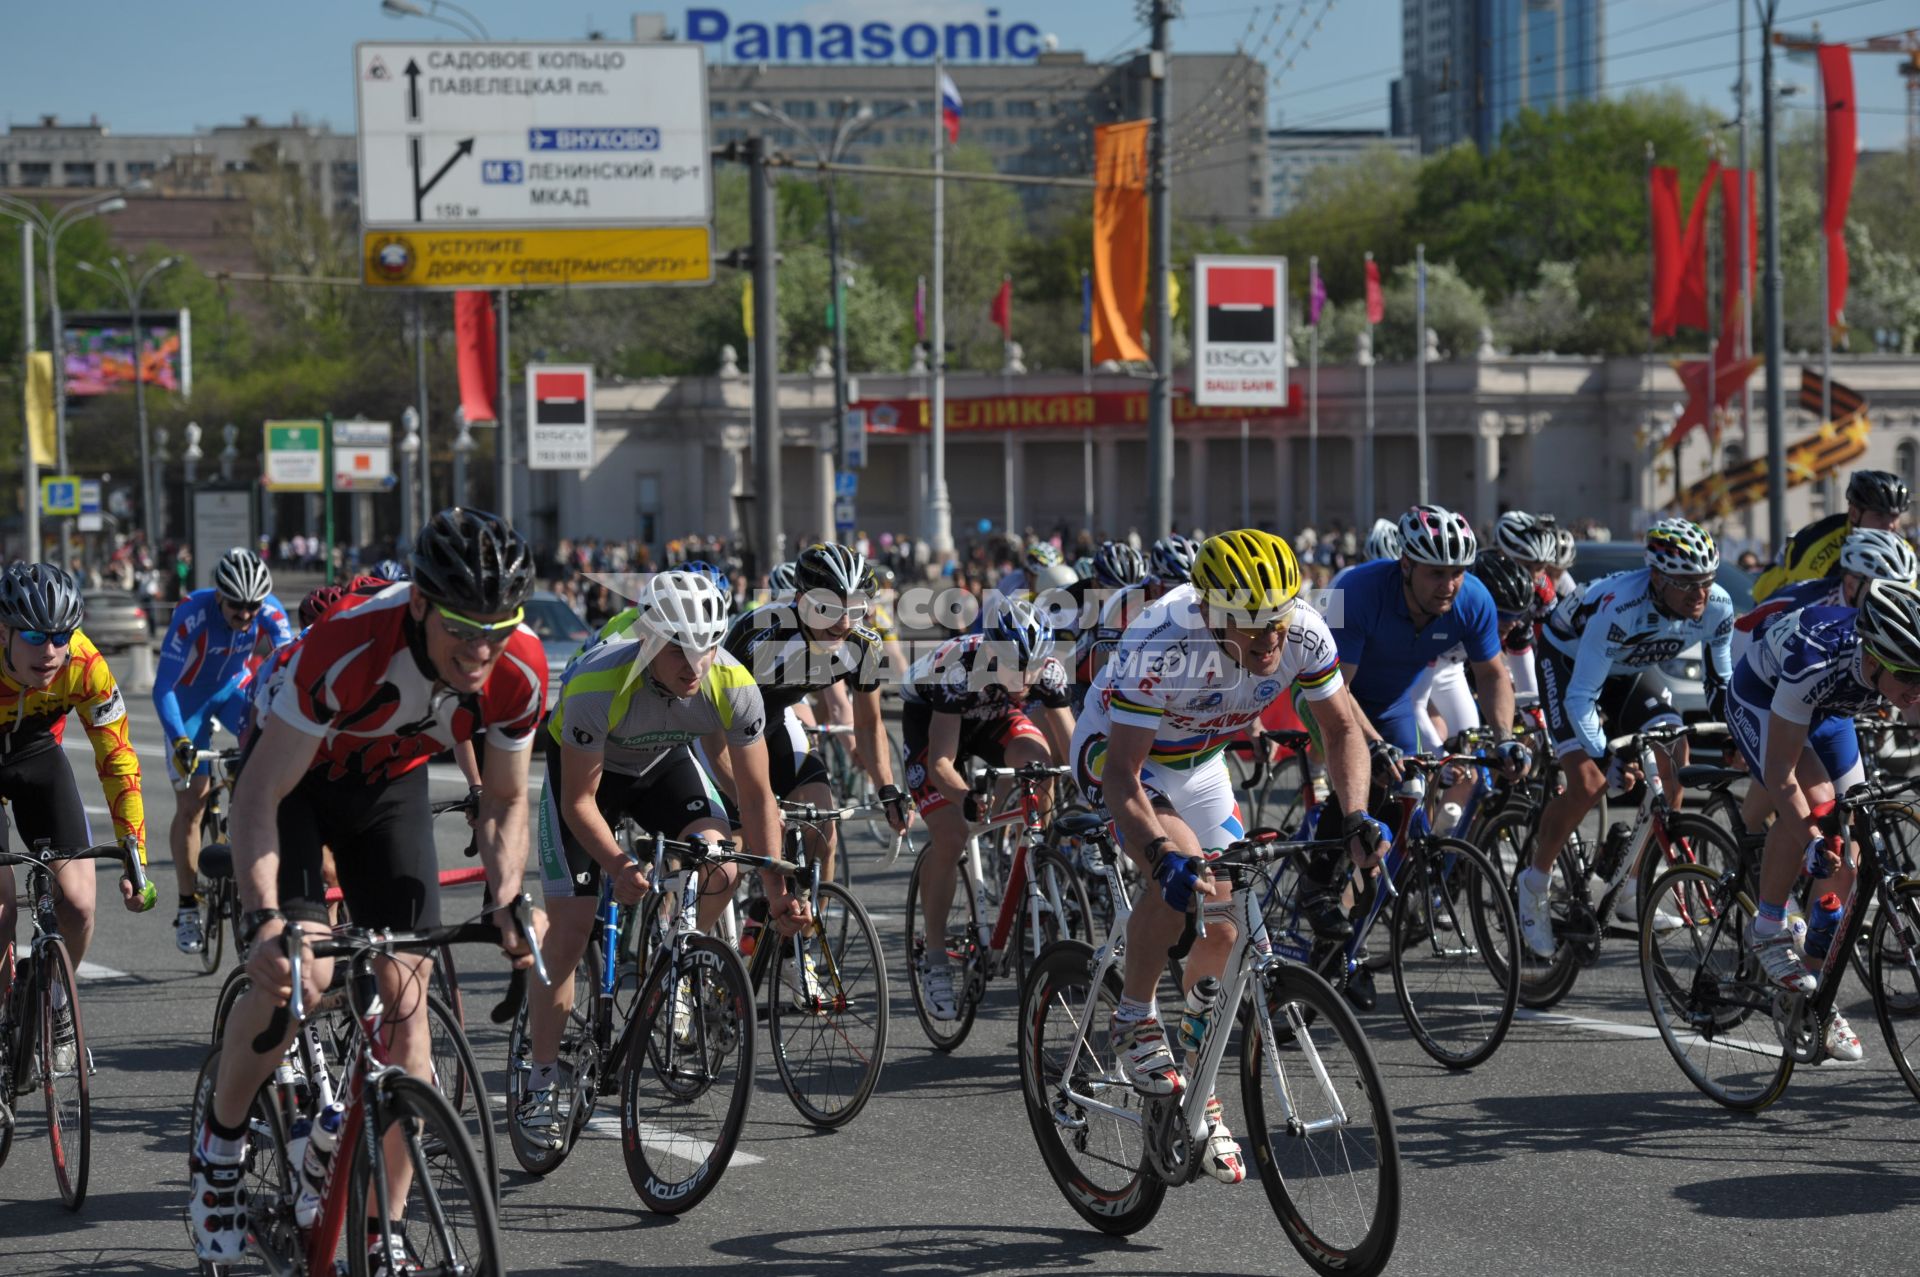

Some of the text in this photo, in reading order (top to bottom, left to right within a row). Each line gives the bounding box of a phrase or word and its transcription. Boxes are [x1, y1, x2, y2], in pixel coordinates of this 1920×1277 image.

[687, 8, 1043, 60] Panasonic
[428, 51, 625, 72] САДОВОЕ КОЛЬЦО
[429, 78, 572, 97] ПАВЕЛЕЦКАЯ
[556, 129, 658, 149] ВНУКОВО
[529, 159, 701, 183] ЛЕНИНСКИЙ пр-т
[530, 188, 590, 206] МКАД
[428, 239, 525, 256] УСТУПИТЕ
[427, 259, 504, 279] ДОРОГУ
[1206, 349, 1278, 366] BSGV
[1541, 658, 1561, 730] SUNGARD
[1734, 706, 1759, 748] Dynamo
[644, 1159, 710, 1200] EASTON
